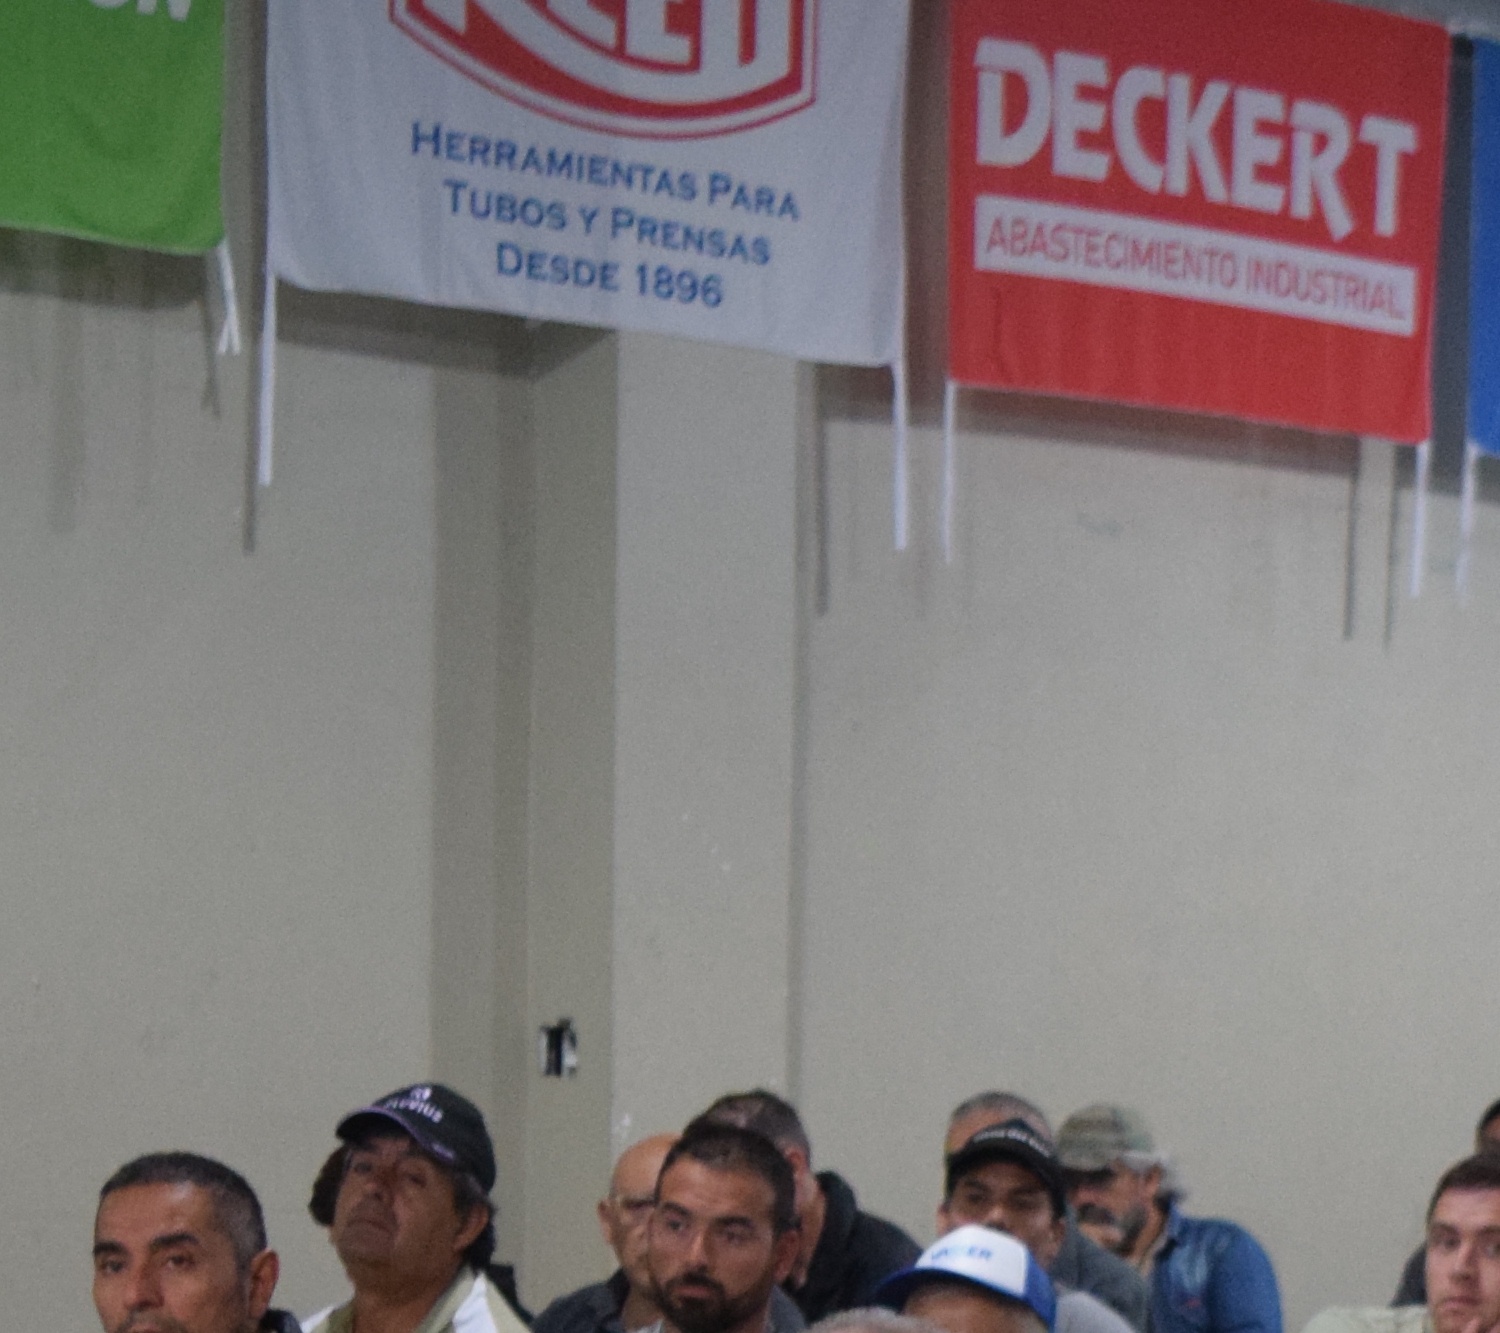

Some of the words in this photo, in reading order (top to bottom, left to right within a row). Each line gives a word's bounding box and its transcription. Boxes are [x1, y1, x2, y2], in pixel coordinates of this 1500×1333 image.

[974, 36, 1418, 242] DECKERT
[576, 205, 600, 235] Y
[635, 262, 725, 308] 1896
[987, 217, 1238, 292] ABASTECIMIENTO
[1247, 258, 1405, 321] INDUSTRIAL
